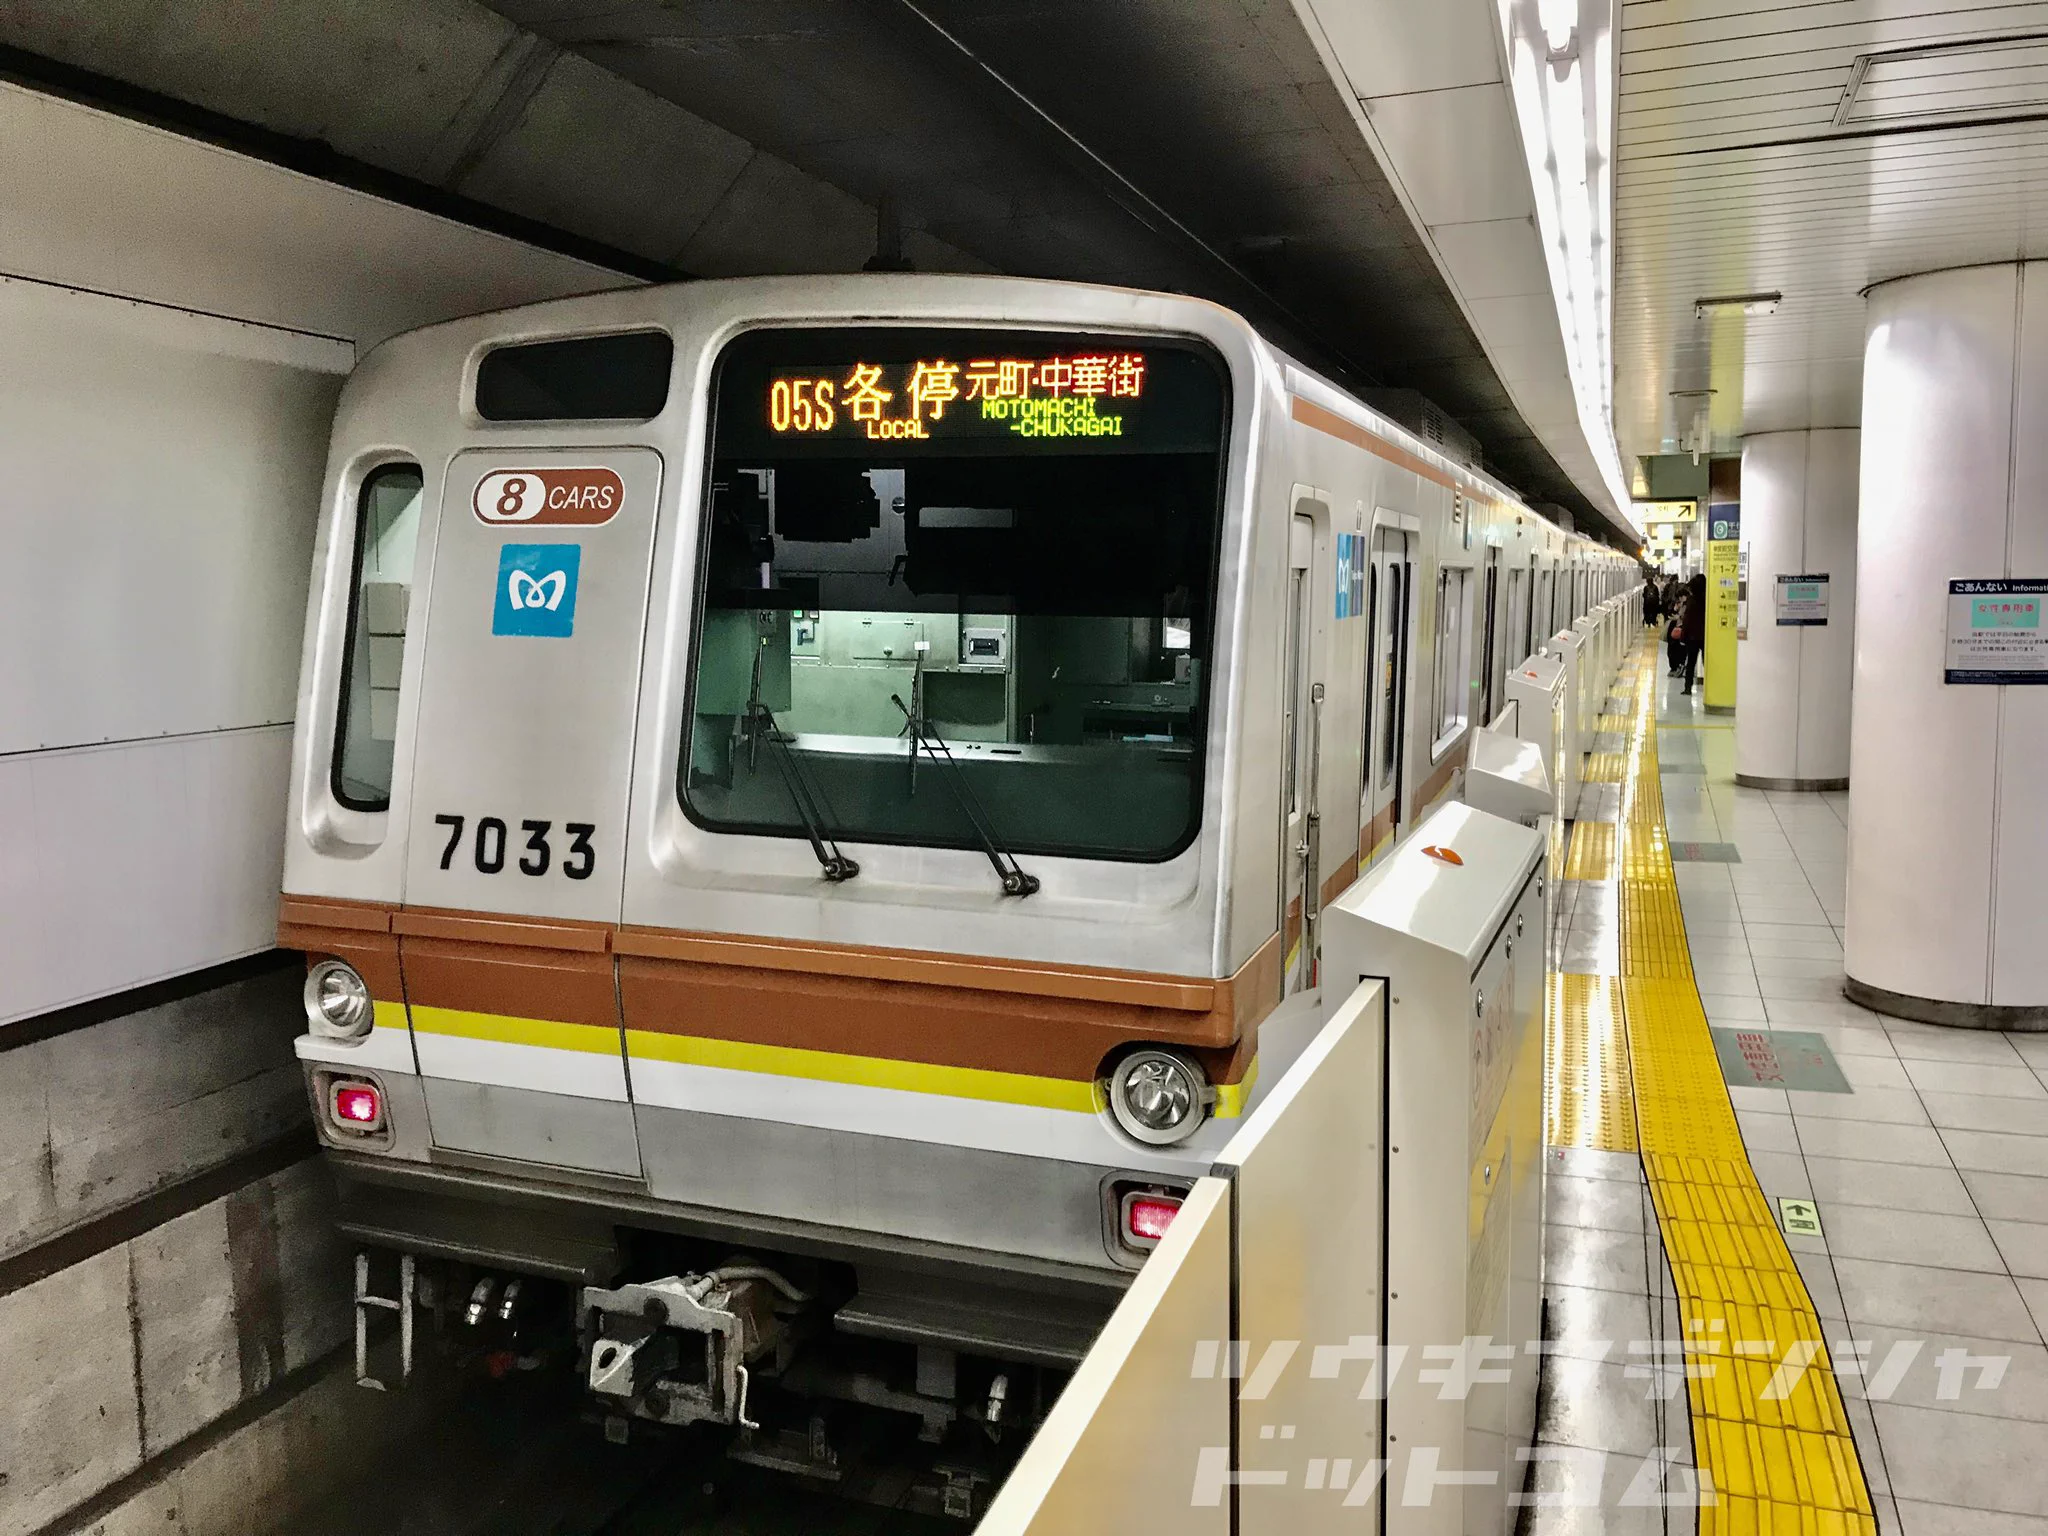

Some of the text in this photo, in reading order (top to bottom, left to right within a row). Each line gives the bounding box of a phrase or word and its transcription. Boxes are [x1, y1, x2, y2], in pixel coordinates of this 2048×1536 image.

[771, 380, 834, 431] 05S
[965, 355, 1144, 401] 元町・中華街
[982, 398, 1096, 419] MOTOMACHI
[867, 418, 930, 439] LOCAL
[1010, 416, 1122, 437] -CHUKAGAI
[496, 478, 615, 516] 8 CARS
[435, 814, 596, 880] 7033
